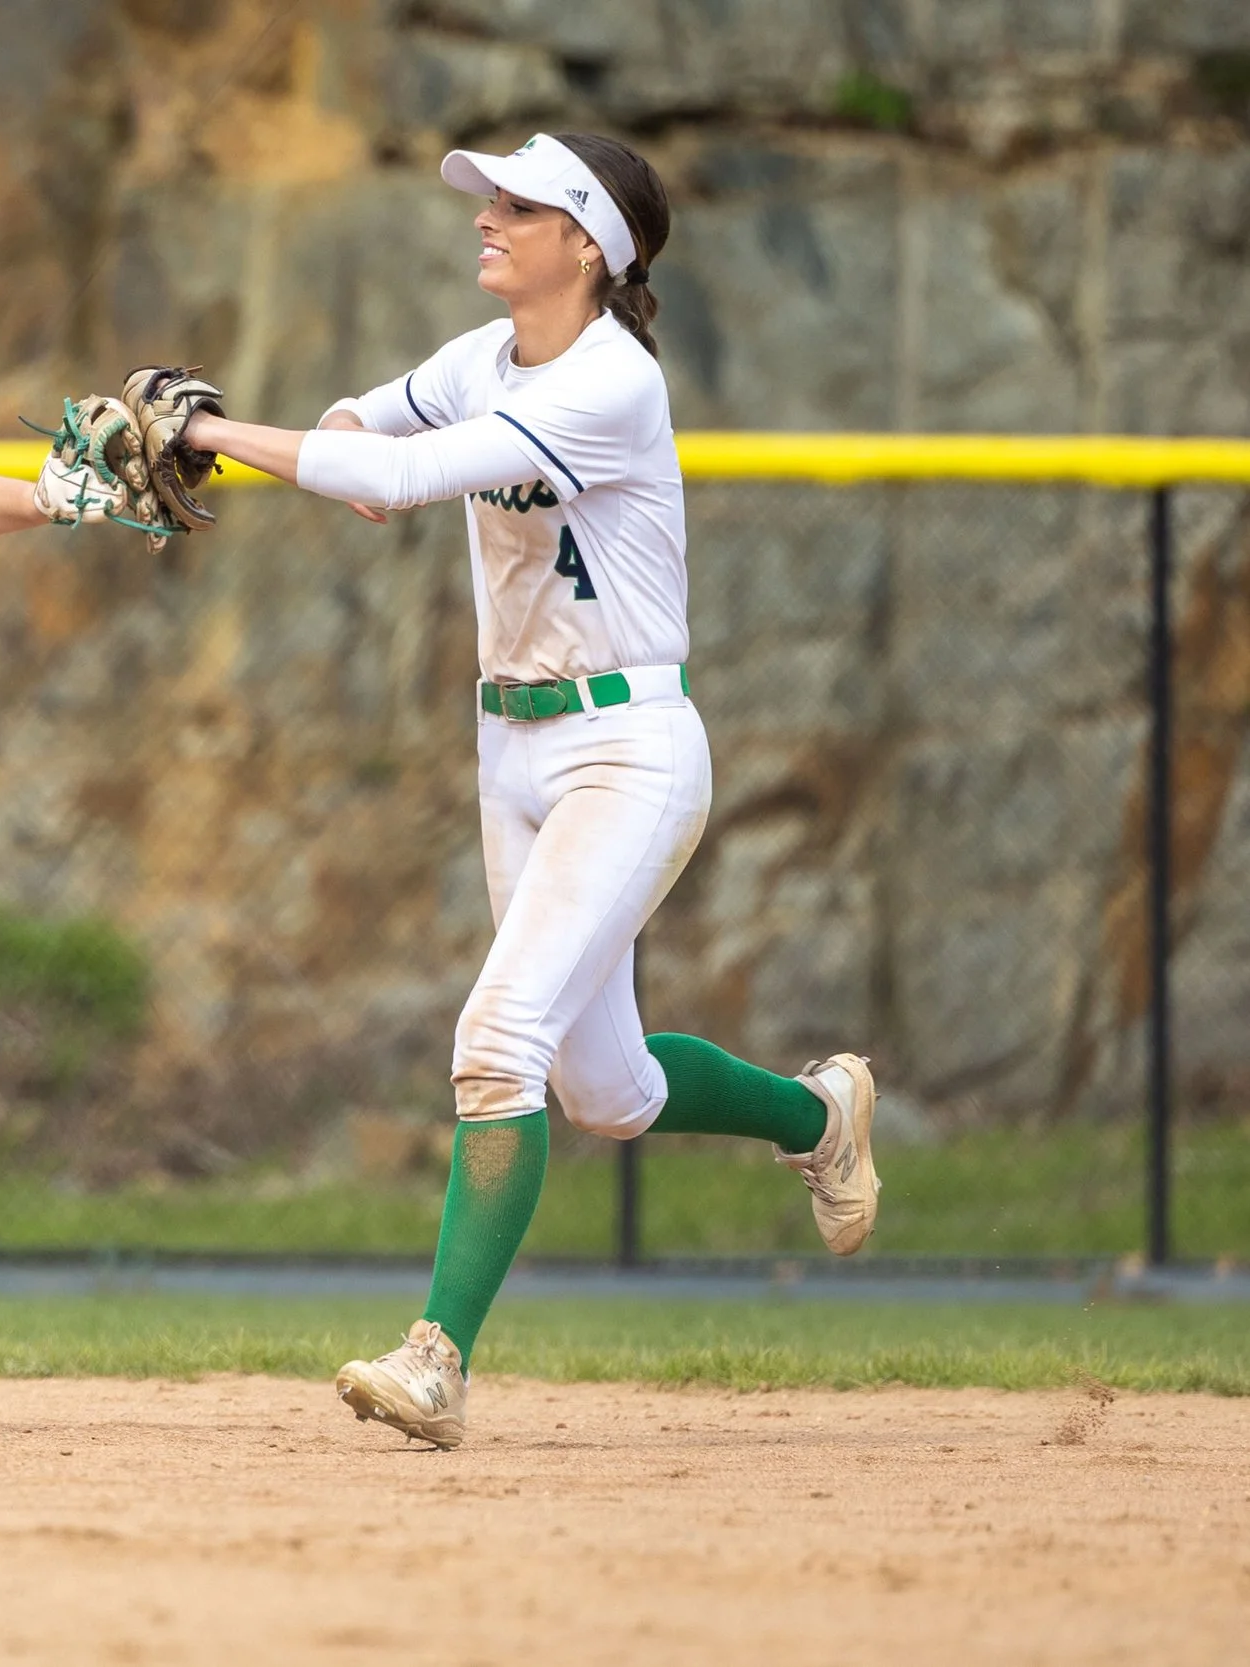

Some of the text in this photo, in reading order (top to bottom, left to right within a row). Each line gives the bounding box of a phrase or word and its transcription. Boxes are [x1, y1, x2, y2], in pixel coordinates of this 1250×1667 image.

[565, 188, 586, 213] adidas
[554, 524, 598, 601] 4
[426, 1382, 448, 1414] N
